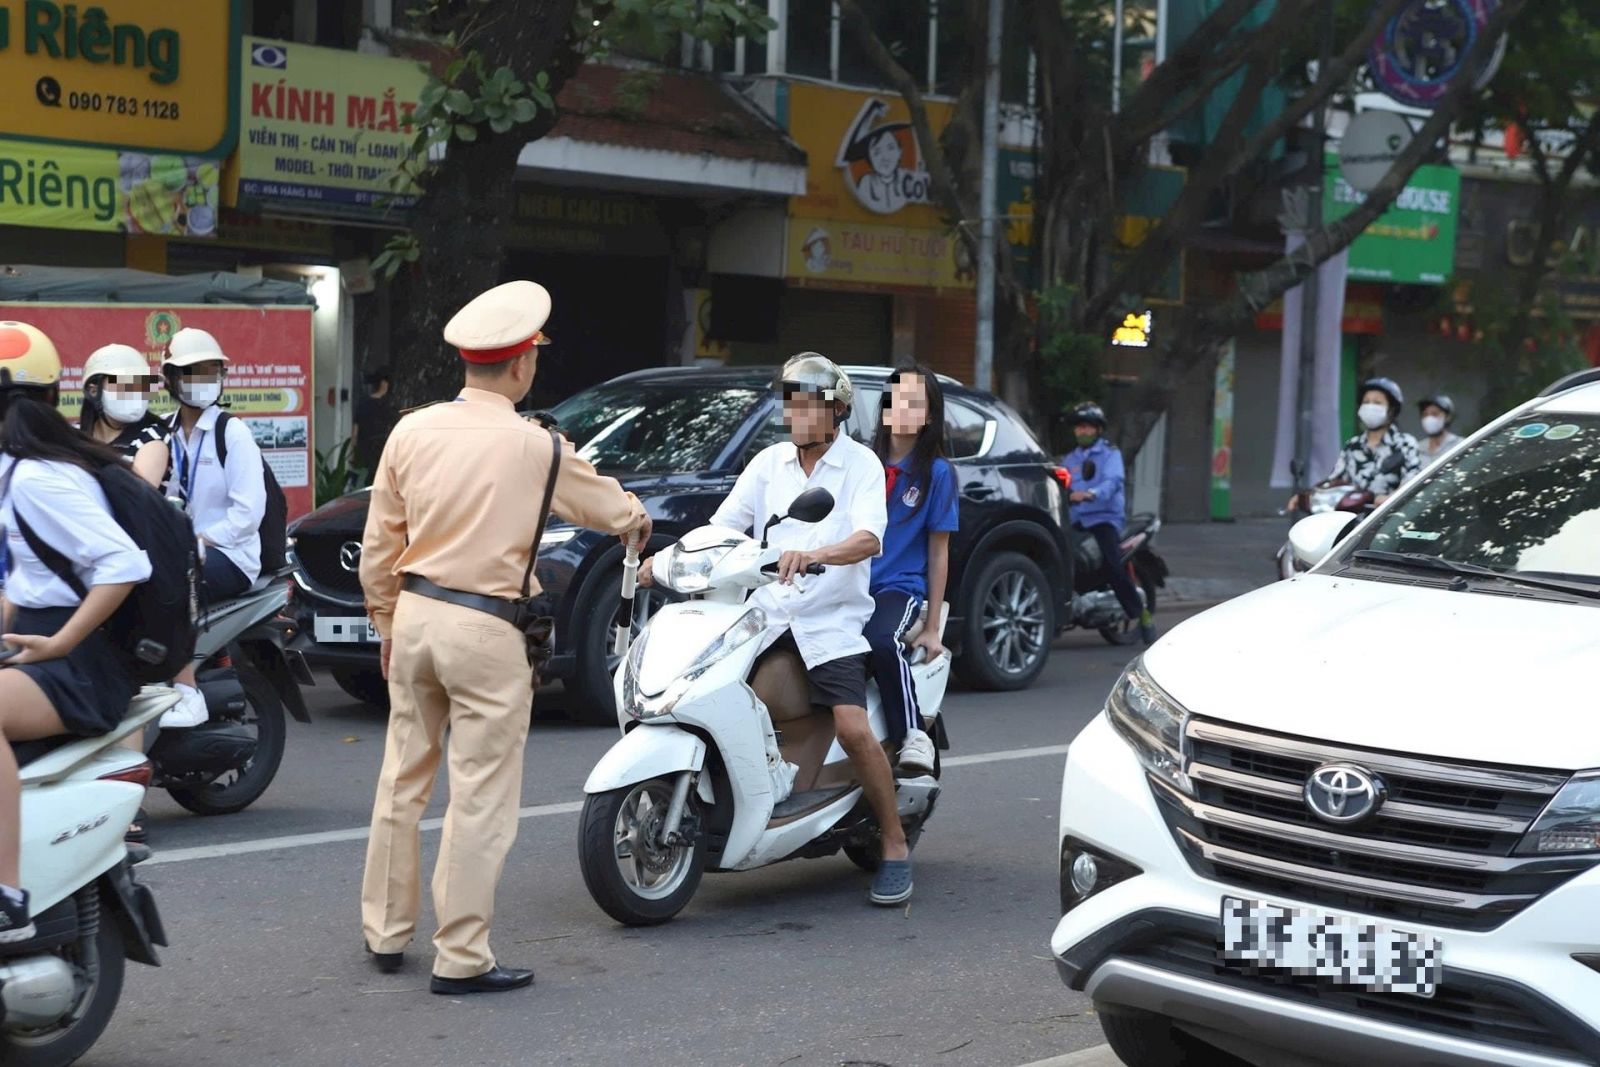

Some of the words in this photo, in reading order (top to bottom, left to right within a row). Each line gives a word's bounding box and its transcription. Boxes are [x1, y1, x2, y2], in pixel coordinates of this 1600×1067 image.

[24, 0, 180, 85] Riêng
[69, 91, 101, 111] 090
[106, 95, 138, 116] 783
[143, 100, 180, 120] 1128
[251, 78, 334, 125] KÍNH
[0, 157, 115, 221] Riêng
[275, 157, 315, 174] MODEL
